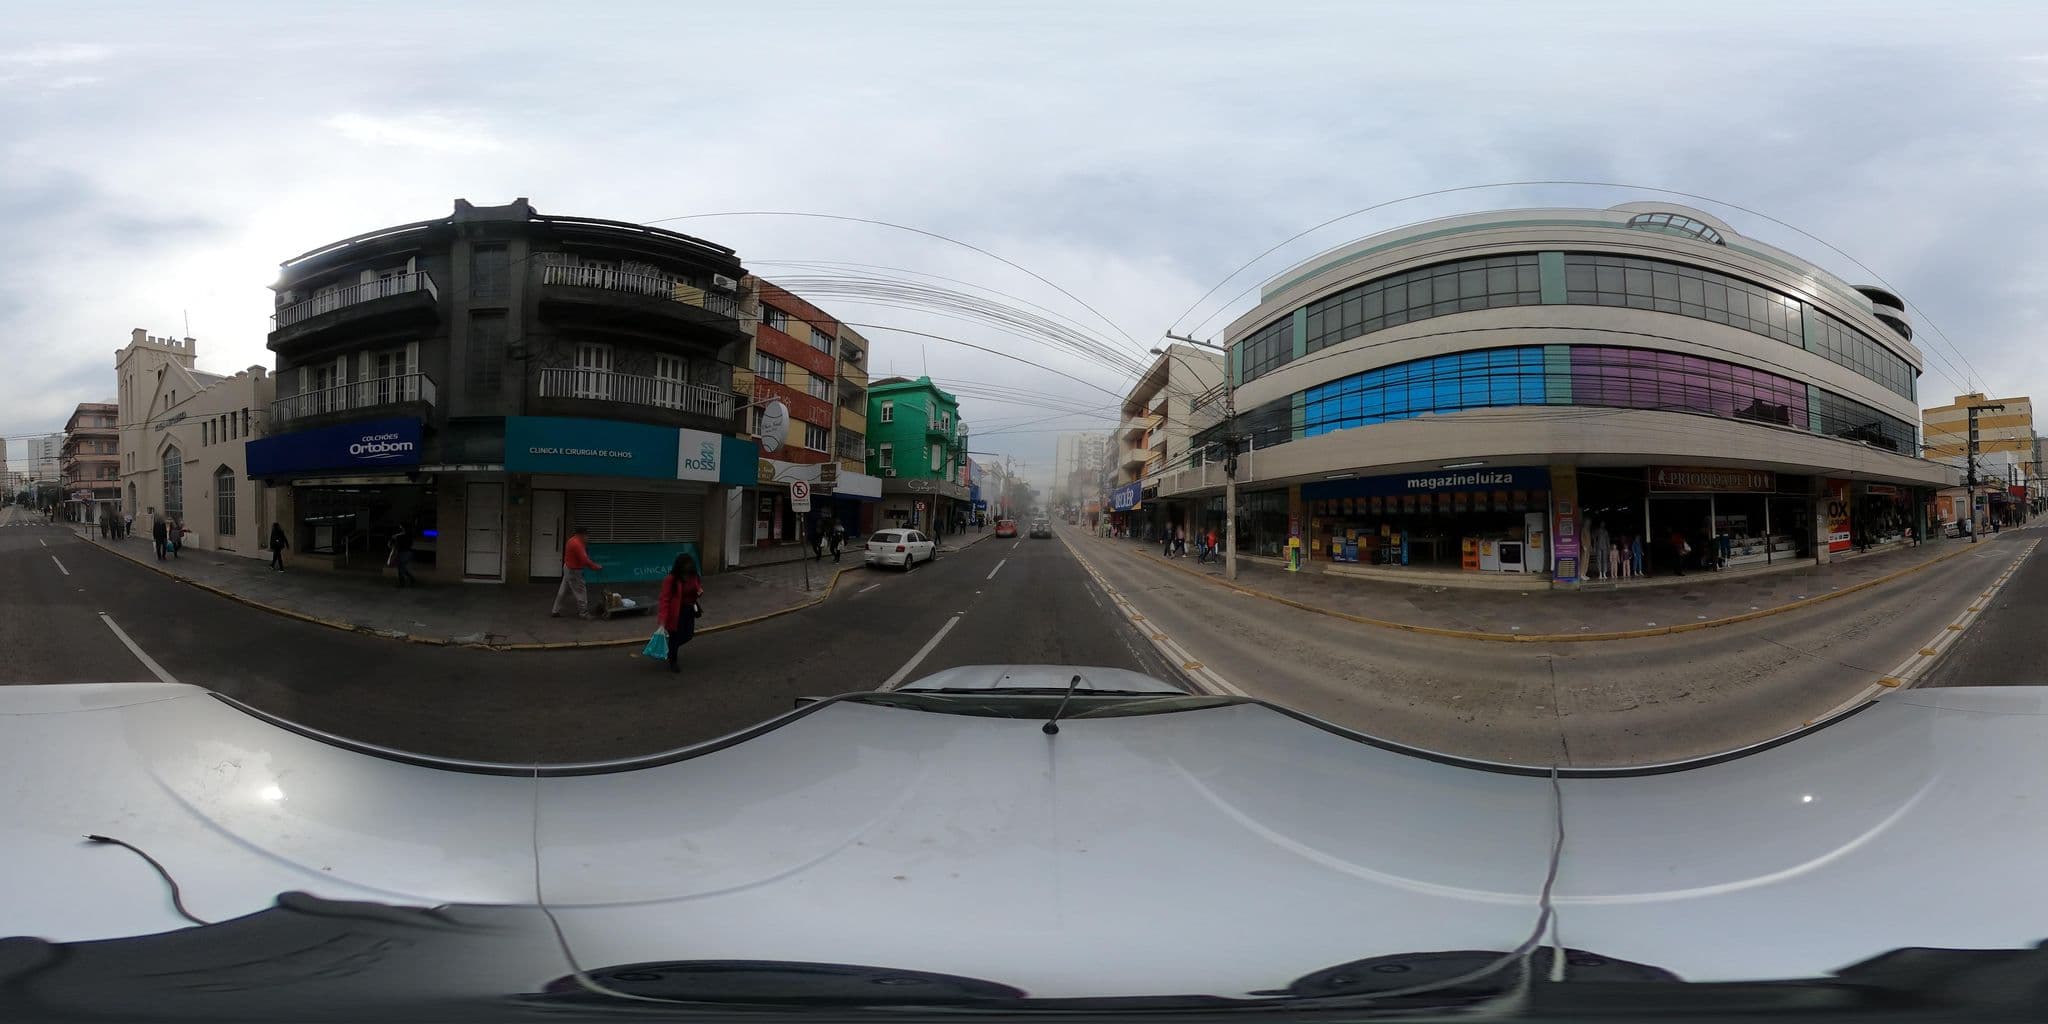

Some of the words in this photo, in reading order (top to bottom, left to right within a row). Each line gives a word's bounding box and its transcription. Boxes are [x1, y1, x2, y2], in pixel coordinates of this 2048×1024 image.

[350, 442, 413, 455] Ortobom
[609, 450, 632, 458] OLHOS
[685, 459, 716, 471] ROSSI
[1407, 471, 1512, 489] magazineluiza
